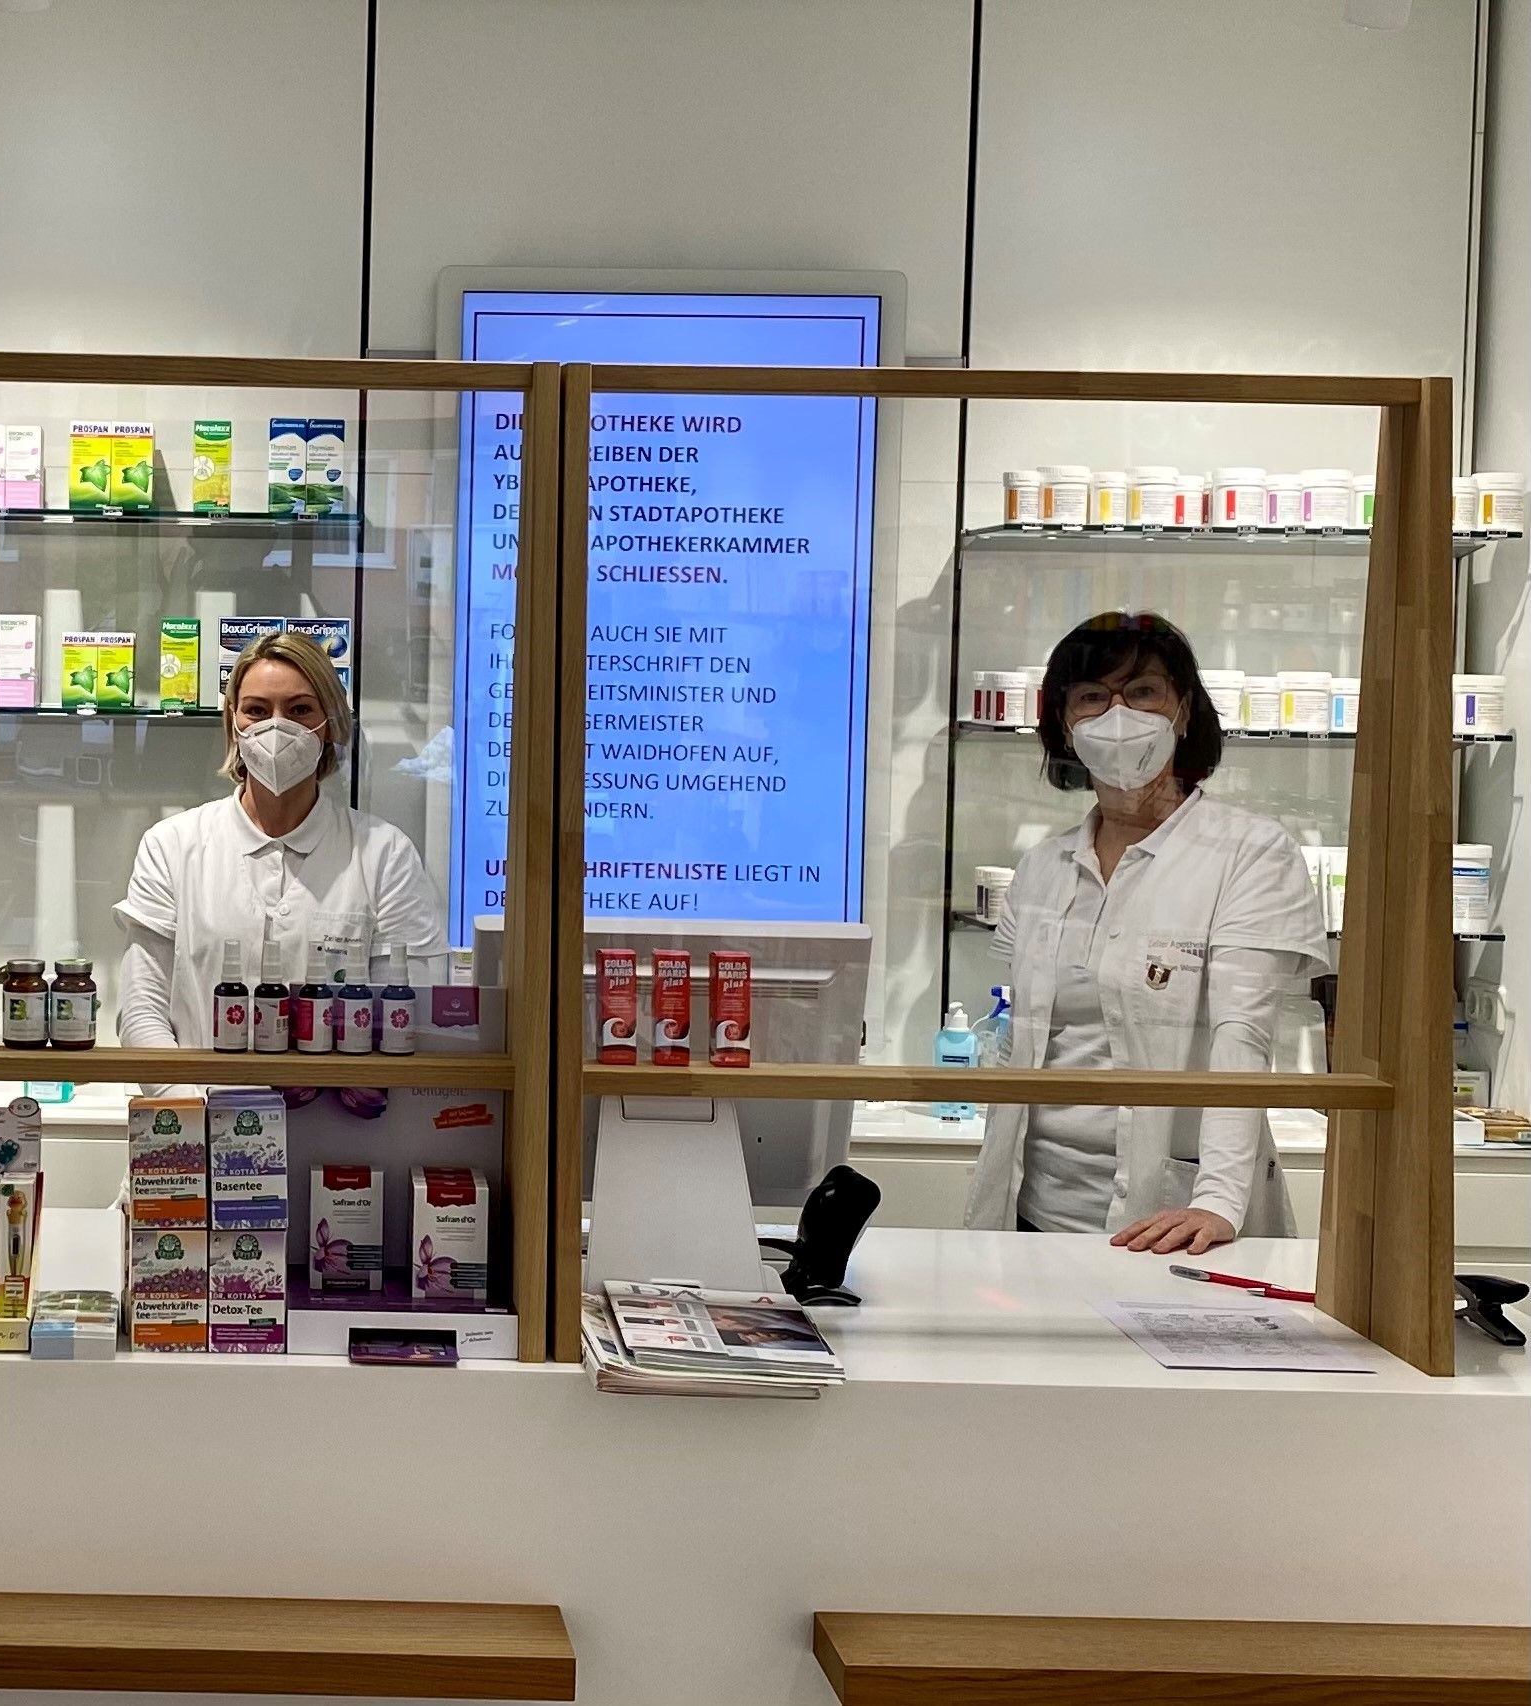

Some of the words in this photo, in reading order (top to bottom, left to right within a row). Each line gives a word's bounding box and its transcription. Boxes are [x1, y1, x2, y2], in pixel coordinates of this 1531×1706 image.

[73, 425, 108, 433] PROSPAN
[115, 425, 150, 434] PROSPAN
[591, 415, 675, 432] OTHEKE
[682, 416, 742, 433] WIRD
[659, 447, 698, 463] DER
[609, 506, 784, 525] STADTAPOTHEKE
[591, 536, 809, 554] APOTHEKERKAMMER
[596, 566, 728, 584] SCHLIESSEN.
[591, 625, 647, 642] AUCH
[654, 627, 682, 643] SIE
[689, 627, 728, 644] MIT
[587, 655, 704, 672] TERSCHRIFT
[710, 657, 751, 673] DEN
[732, 687, 776, 704] UND
[602, 744, 726, 762] WAIDHOFEN
[733, 746, 778, 765] AUF,
[666, 774, 786, 792] UMGEHEND
[734, 865, 789, 882] LIEGT
[799, 865, 820, 882] IN
[648, 894, 698, 911] AUF!
[609, 977, 629, 989] plus
[663, 980, 683, 990] plus
[723, 980, 744, 991] plus
[135, 1176, 201, 1186] Abwehrkräfte-
[215, 1181, 262, 1191] Basentee
[135, 1187, 150, 1195] tee
[436, 1216, 459, 1224] Safran
[461, 1216, 476, 1224] d'Or
[136, 1301, 202, 1311] Abwehrkräfte-
[213, 1304, 262, 1315] Detox-Tee
[136, 1311, 151, 1320] tee
